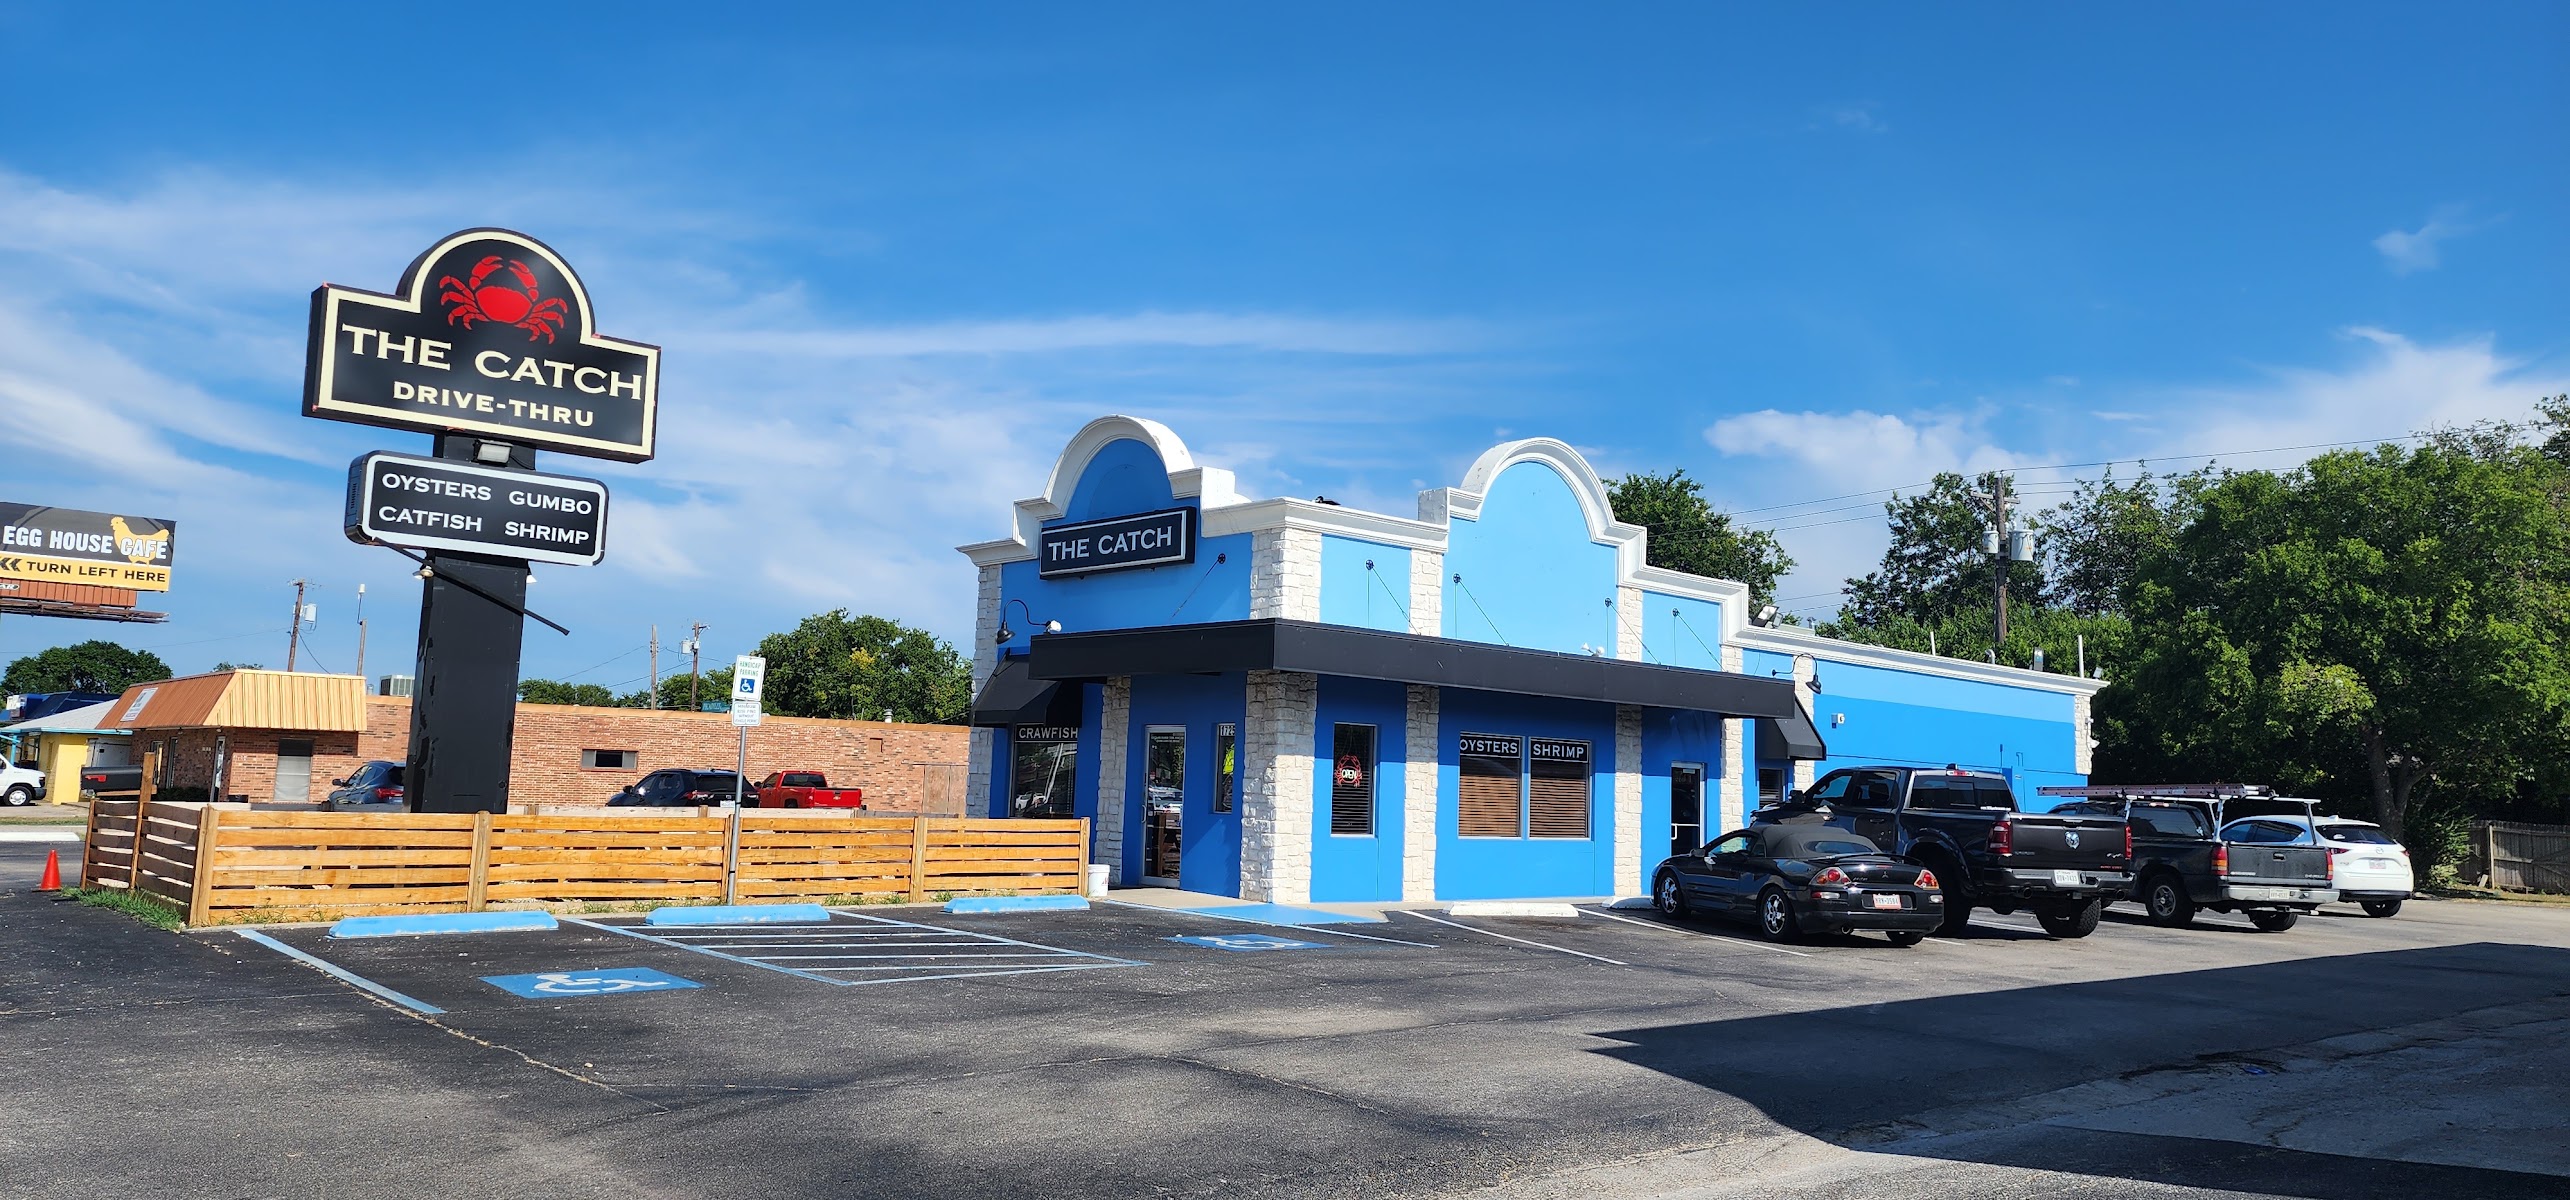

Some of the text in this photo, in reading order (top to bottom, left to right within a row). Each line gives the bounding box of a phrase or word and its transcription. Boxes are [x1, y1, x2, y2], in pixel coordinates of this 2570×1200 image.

[342, 323, 642, 400] THE CATCH
[393, 381, 594, 427] DRIVE-THRU
[382, 473, 592, 515] OYSTERS GUMBO
[3, 525, 168, 559] EGG HOUSE CAFE
[378, 505, 590, 545] CATFISH SHRIMP
[1048, 526, 1172, 561] THE CATCH
[26, 561, 166, 582] TURN LEFT HERE
[1019, 727, 1078, 739] CRAWFISH
[1460, 739, 1518, 754] OYSTERS
[1533, 743, 1584, 758] SHRIMP
[1341, 769, 1357, 779] OPEN
